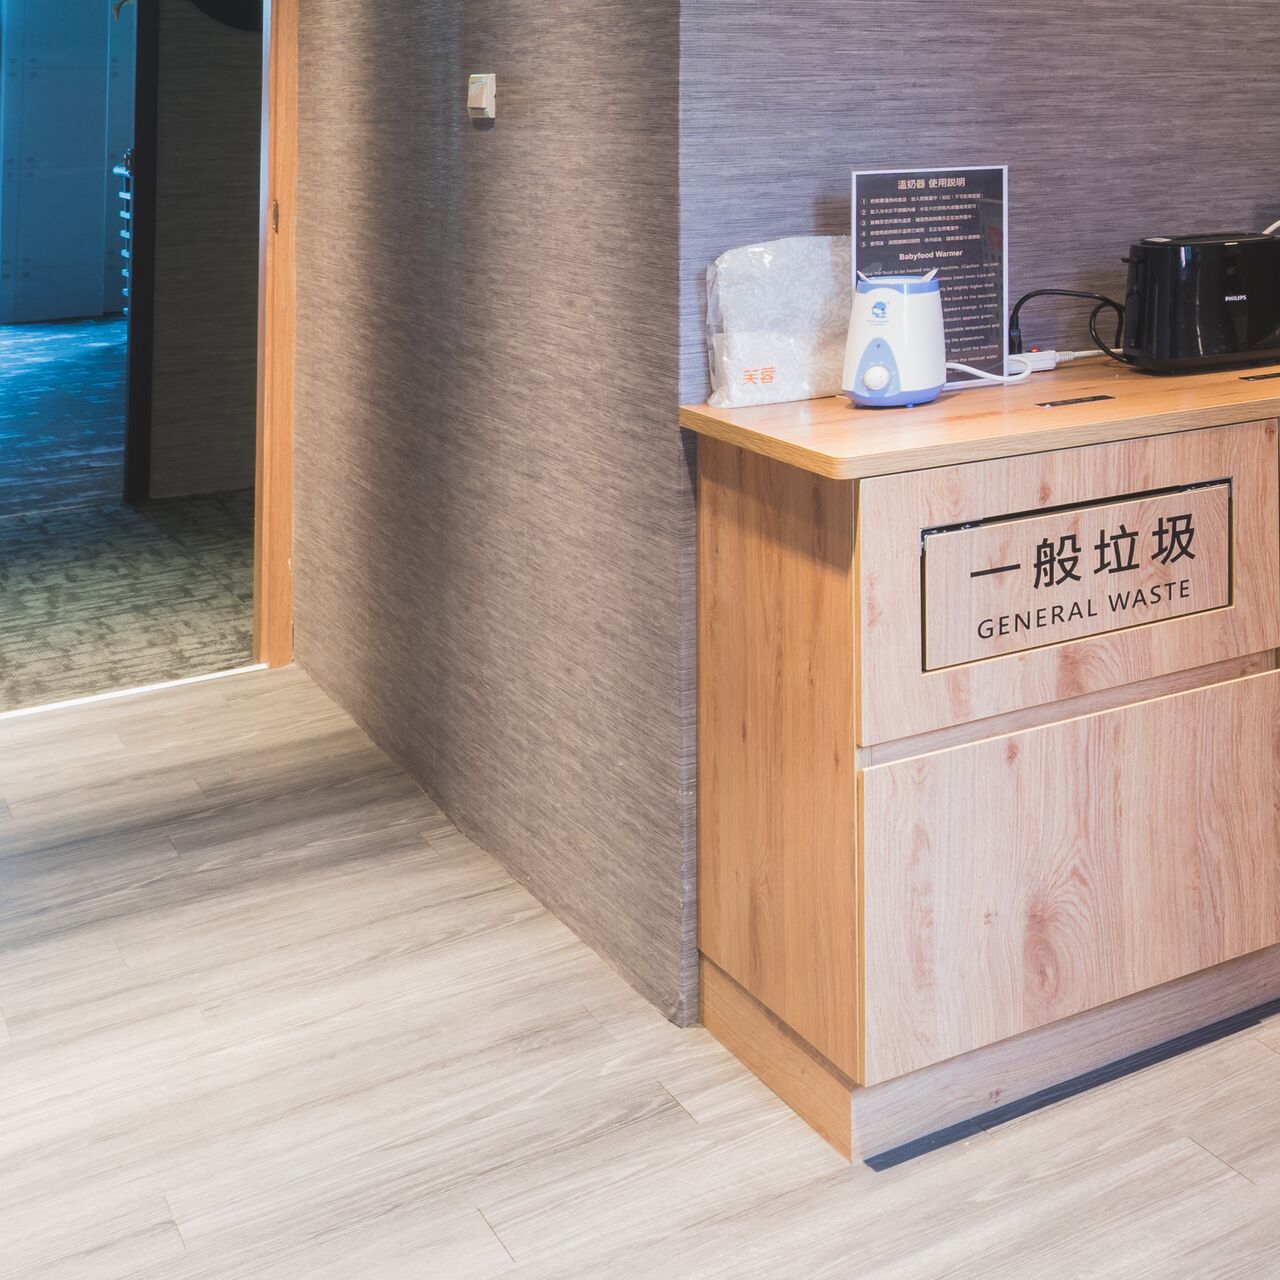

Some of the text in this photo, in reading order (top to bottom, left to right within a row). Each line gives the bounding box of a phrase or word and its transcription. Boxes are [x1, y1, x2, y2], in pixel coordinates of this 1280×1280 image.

[899, 250, 963, 261] Babyfood Warmer
[742, 367, 776, 385] 芙蓉
[970, 513, 1196, 589] 一般垃圾
[977, 579, 1190, 639] GENERAL WASTE
